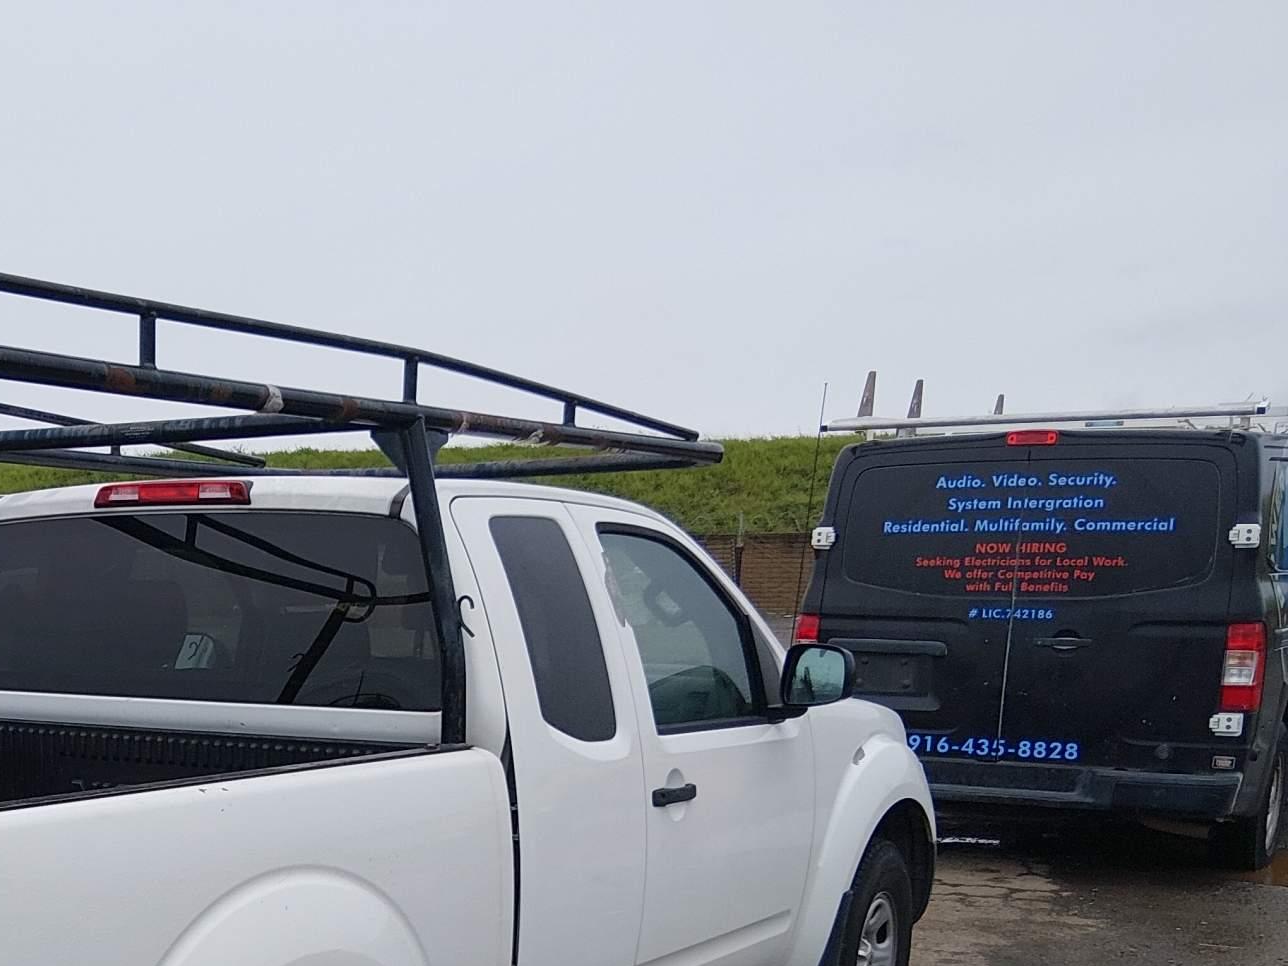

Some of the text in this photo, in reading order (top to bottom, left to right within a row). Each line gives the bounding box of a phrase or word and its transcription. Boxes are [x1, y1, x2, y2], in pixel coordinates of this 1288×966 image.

[936, 472, 1117, 489] Audio. Video. Security.
[948, 496, 1104, 512] System Intergration
[883, 517, 1175, 534] Residential. Multifamily. Commercial
[975, 542, 1067, 553] NOW HIRING
[915, 556, 1129, 568] Seeking Electricians for Local Work.
[944, 569, 1096, 581] We offer Competitive Pay
[965, 582, 991, 592] with
[1020, 582, 1069, 592] Benefits
[968, 608, 1053, 619] # LIC.742186
[908, 734, 1078, 760] 916-435-8828
